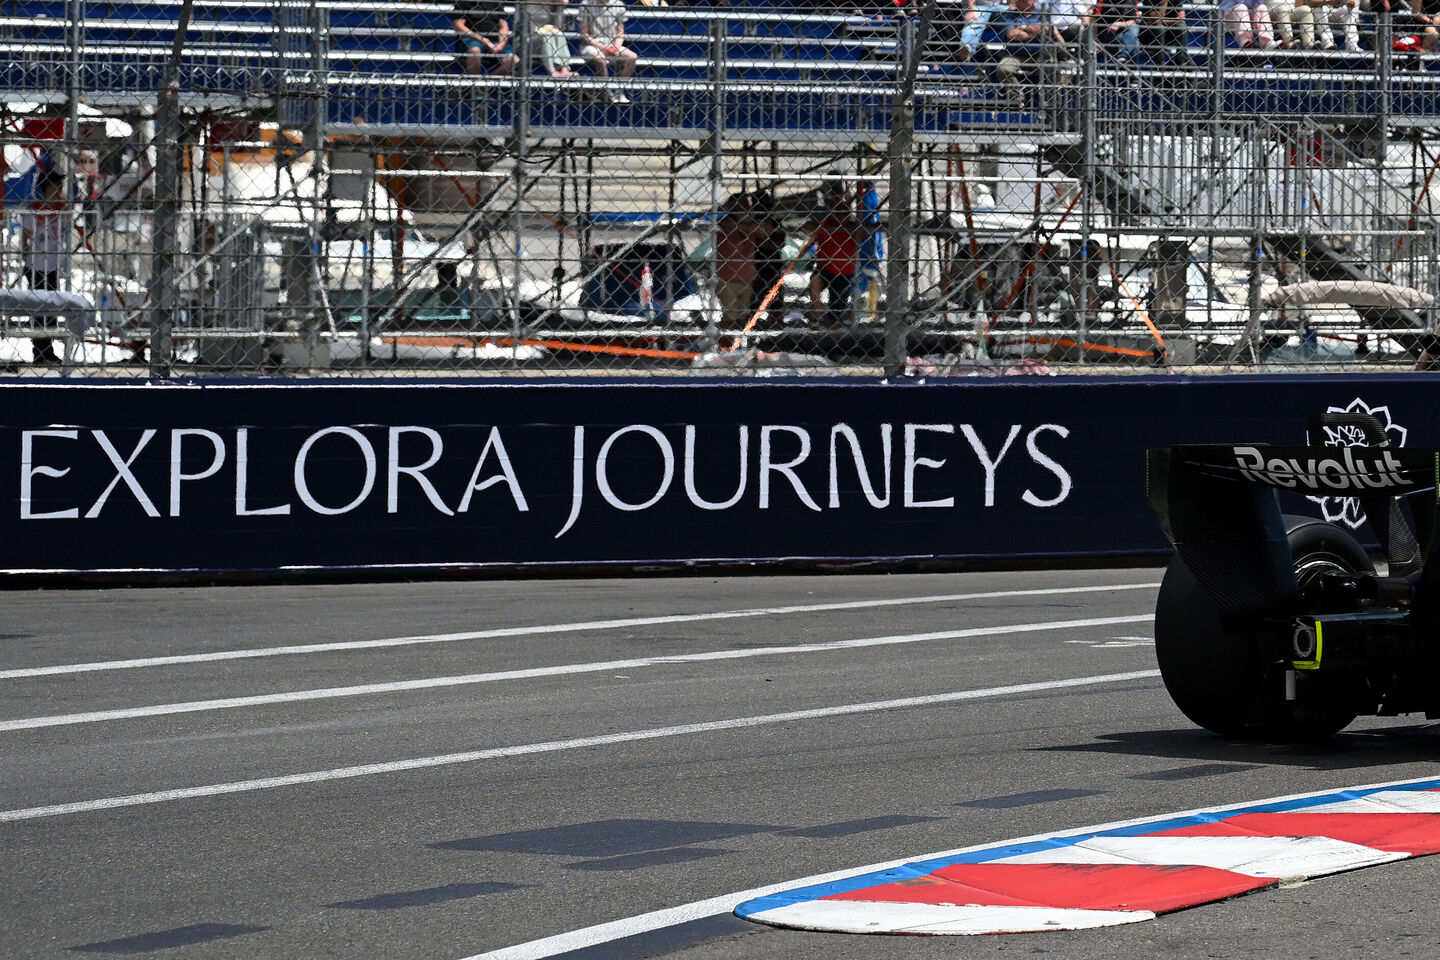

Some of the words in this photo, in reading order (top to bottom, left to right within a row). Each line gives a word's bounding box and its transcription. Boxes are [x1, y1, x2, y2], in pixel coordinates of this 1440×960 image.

[21, 425, 529, 519] EXPLORA
[555, 422, 1072, 539] JOURNEYS
[1234, 447, 1414, 489] Revolut
